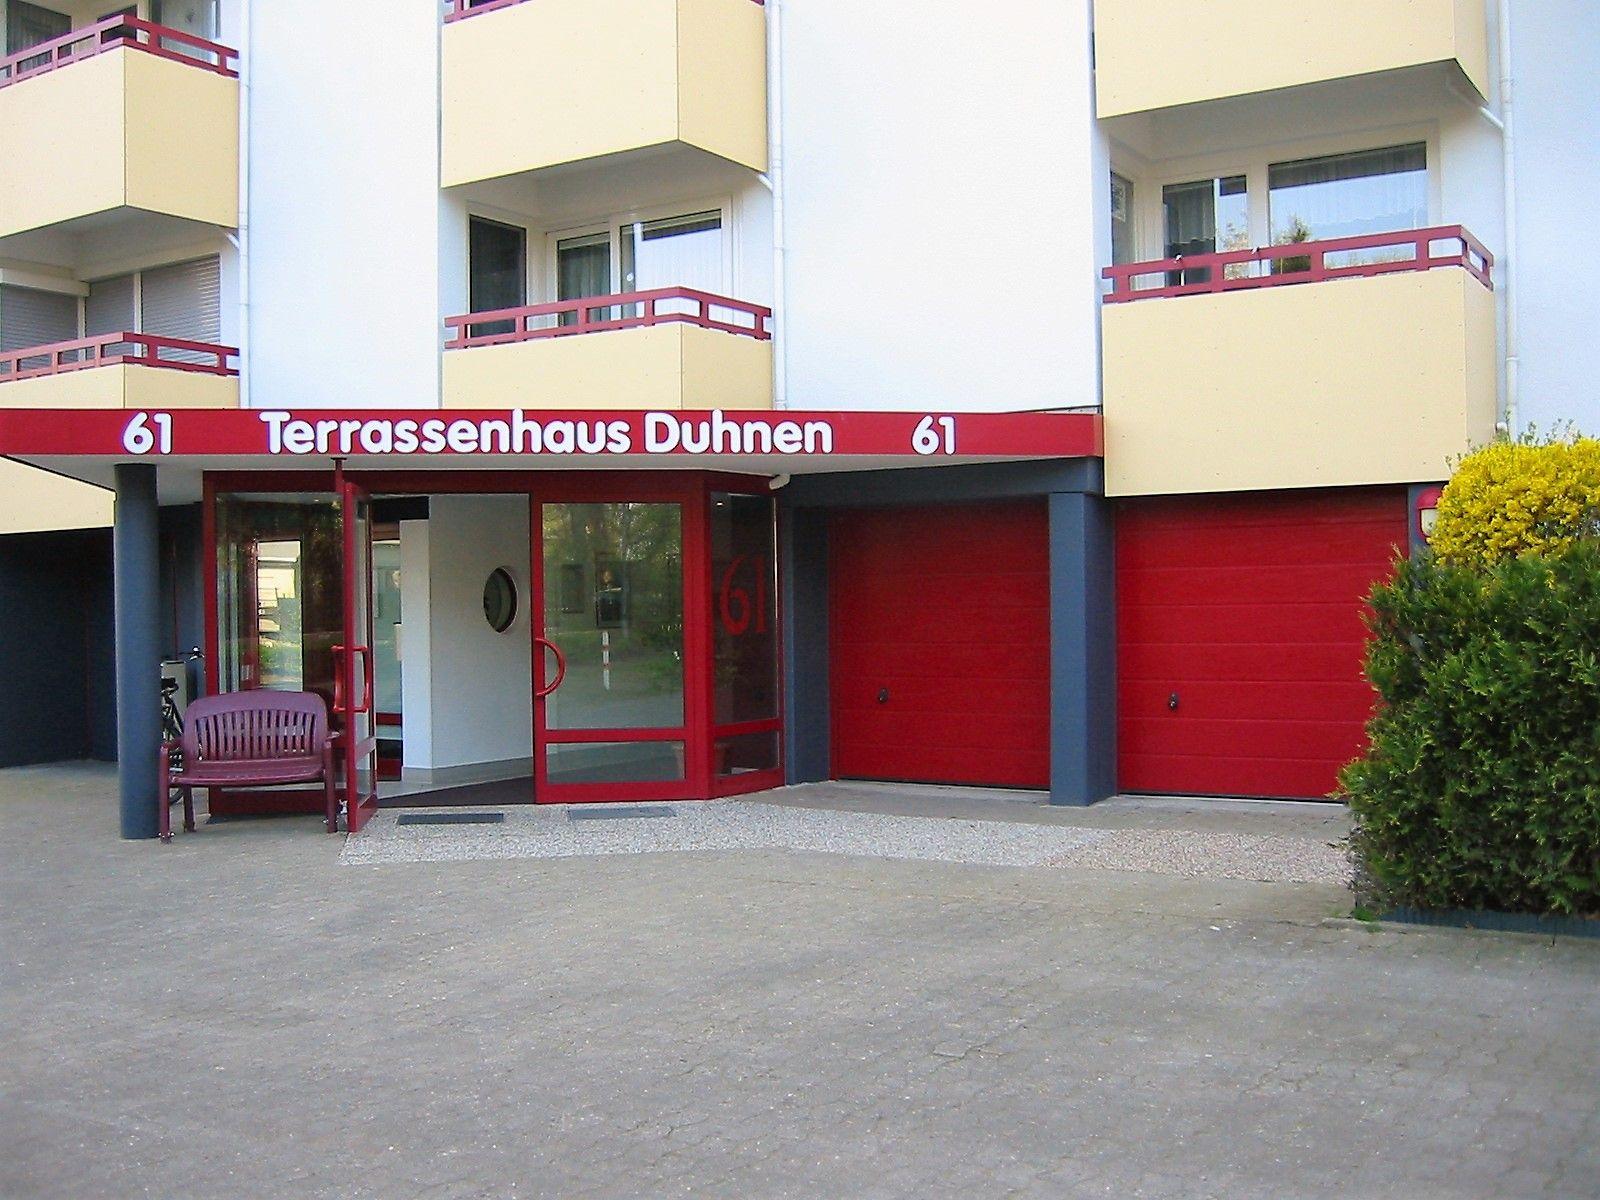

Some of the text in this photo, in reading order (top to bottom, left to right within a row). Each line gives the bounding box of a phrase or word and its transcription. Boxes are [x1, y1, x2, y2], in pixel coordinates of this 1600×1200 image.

[122, 412, 173, 454] 61
[259, 410, 834, 454] Terrassenhaus Duhnen
[912, 415, 956, 455] 61
[719, 555, 767, 635] 61
